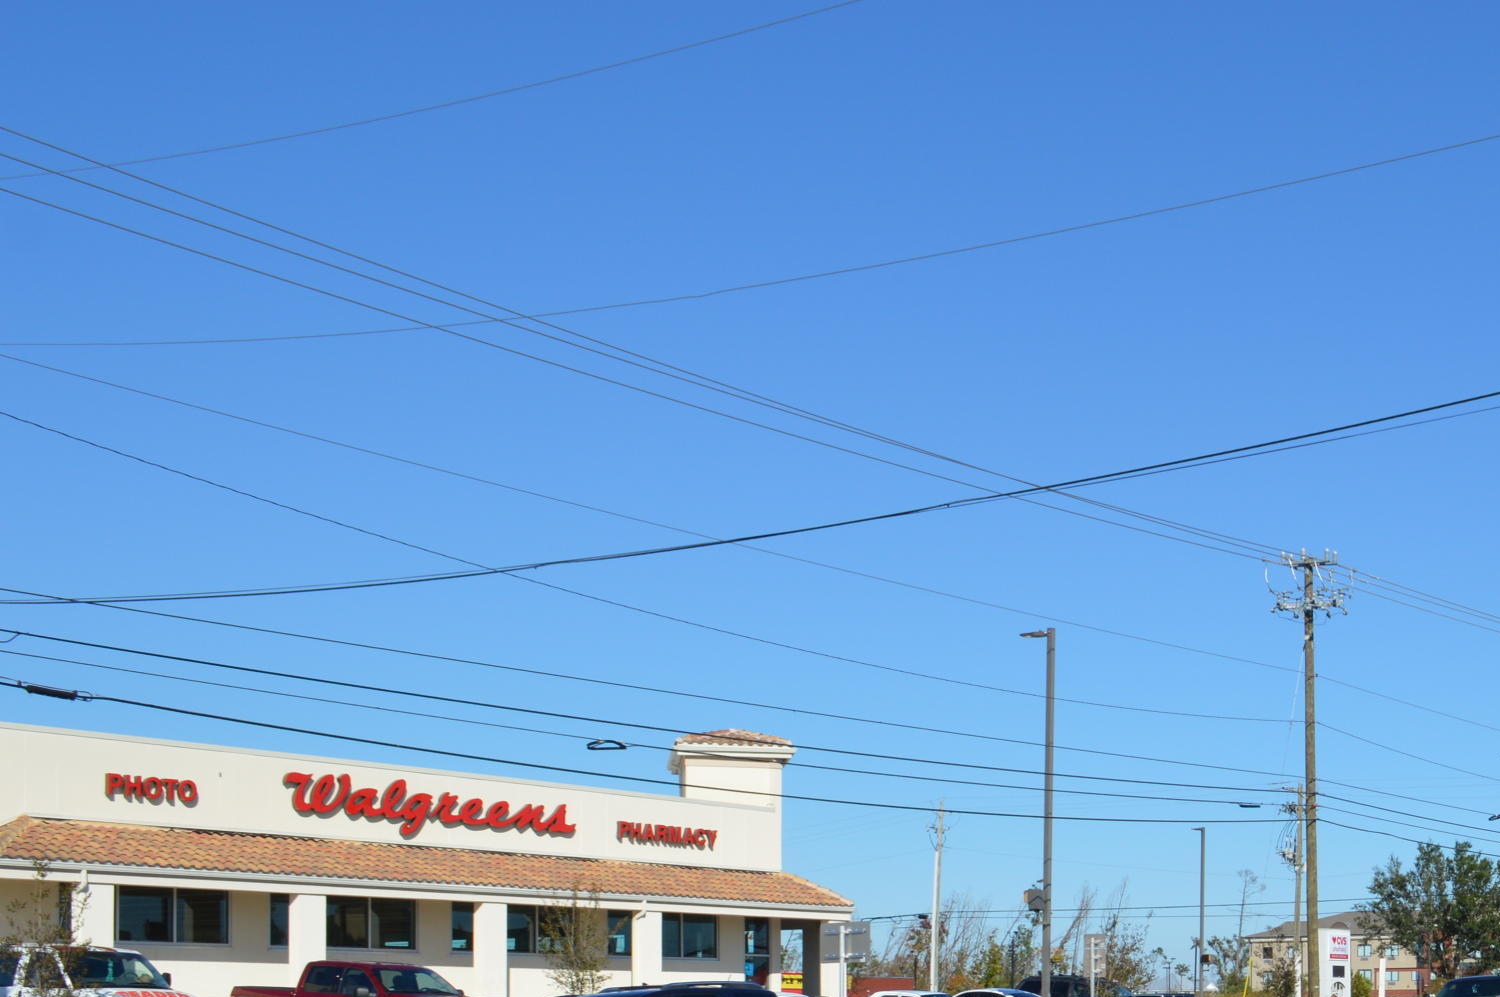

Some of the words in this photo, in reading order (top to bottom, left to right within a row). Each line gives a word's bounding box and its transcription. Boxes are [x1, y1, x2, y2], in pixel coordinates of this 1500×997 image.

[105, 773, 198, 805] PHOTO
[283, 772, 577, 838] Walgreens
[617, 820, 718, 850] PHARMACY
[1337, 937, 1347, 945] CVS
